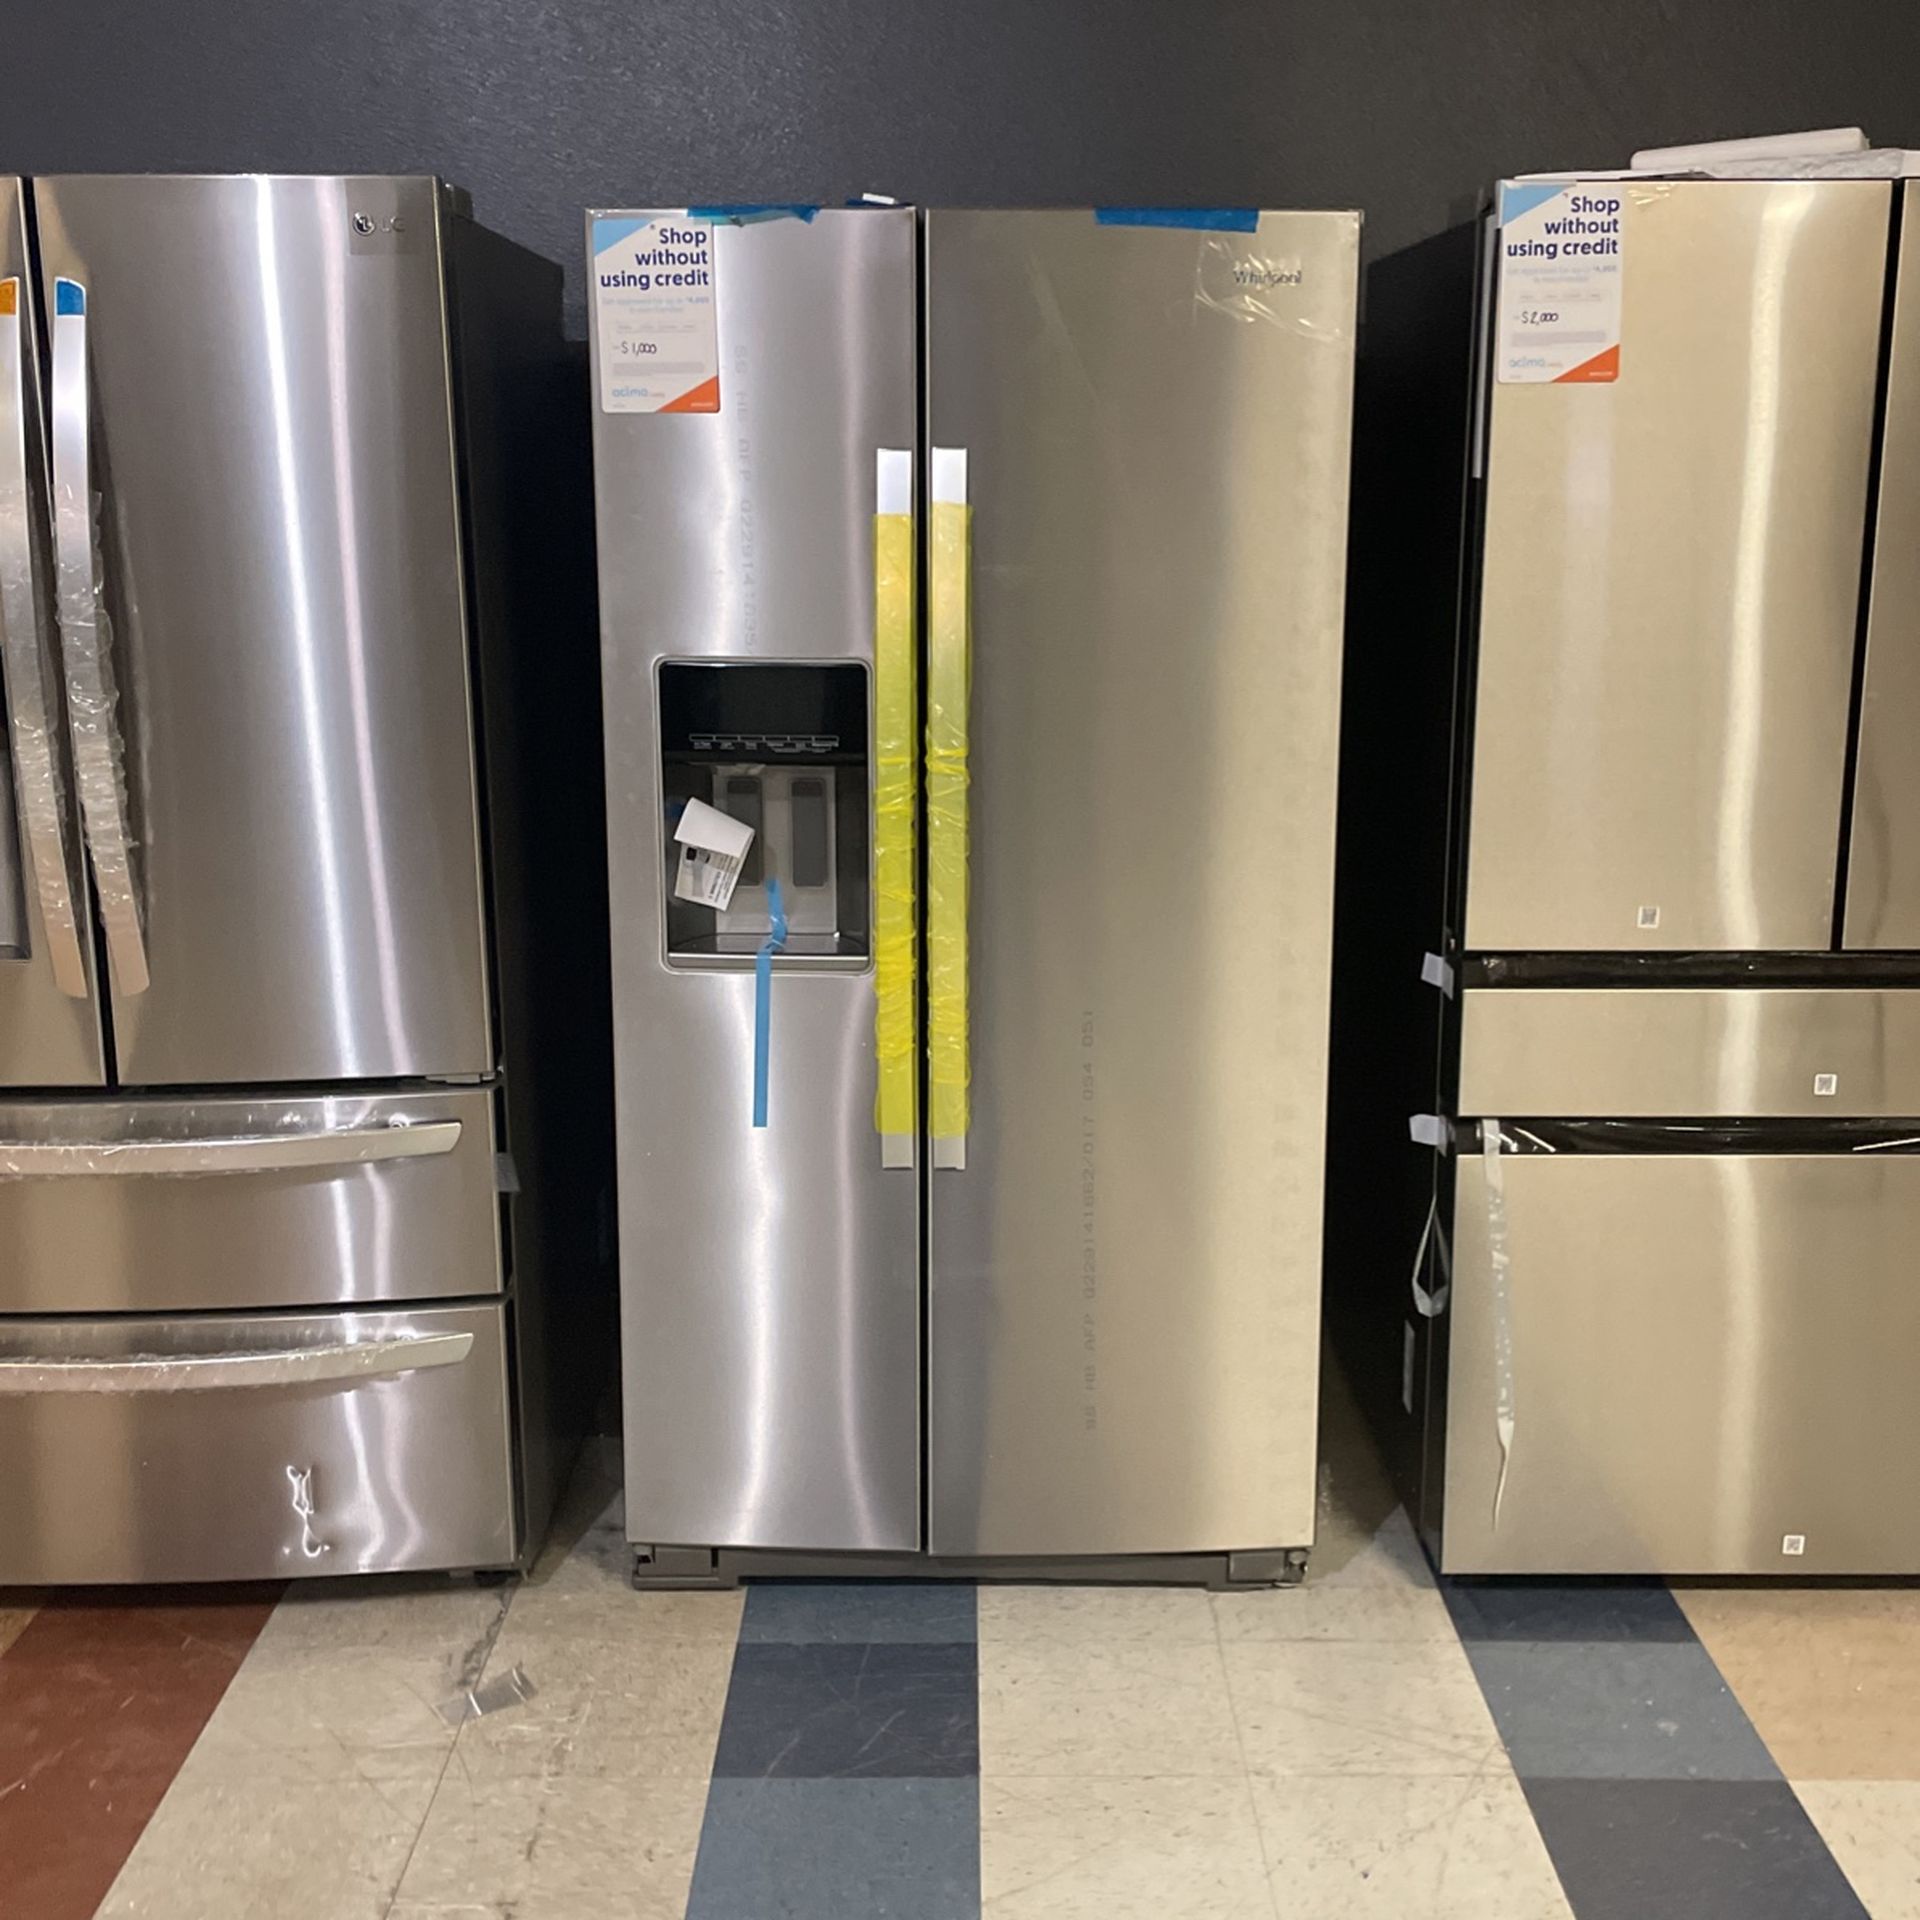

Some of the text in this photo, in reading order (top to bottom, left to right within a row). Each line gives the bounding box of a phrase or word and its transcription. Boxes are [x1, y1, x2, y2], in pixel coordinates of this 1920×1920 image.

[1571, 196, 1620, 216] Shop
[1545, 218, 1619, 235] without
[659, 228, 707, 247] Shop
[1507, 237, 1618, 260] using credit
[635, 249, 708, 266] without
[600, 269, 709, 290] using credit
[1233, 270, 1302, 287] Whirlpool
[1508, 354, 1546, 368] acima
[611, 385, 648, 398] acima
